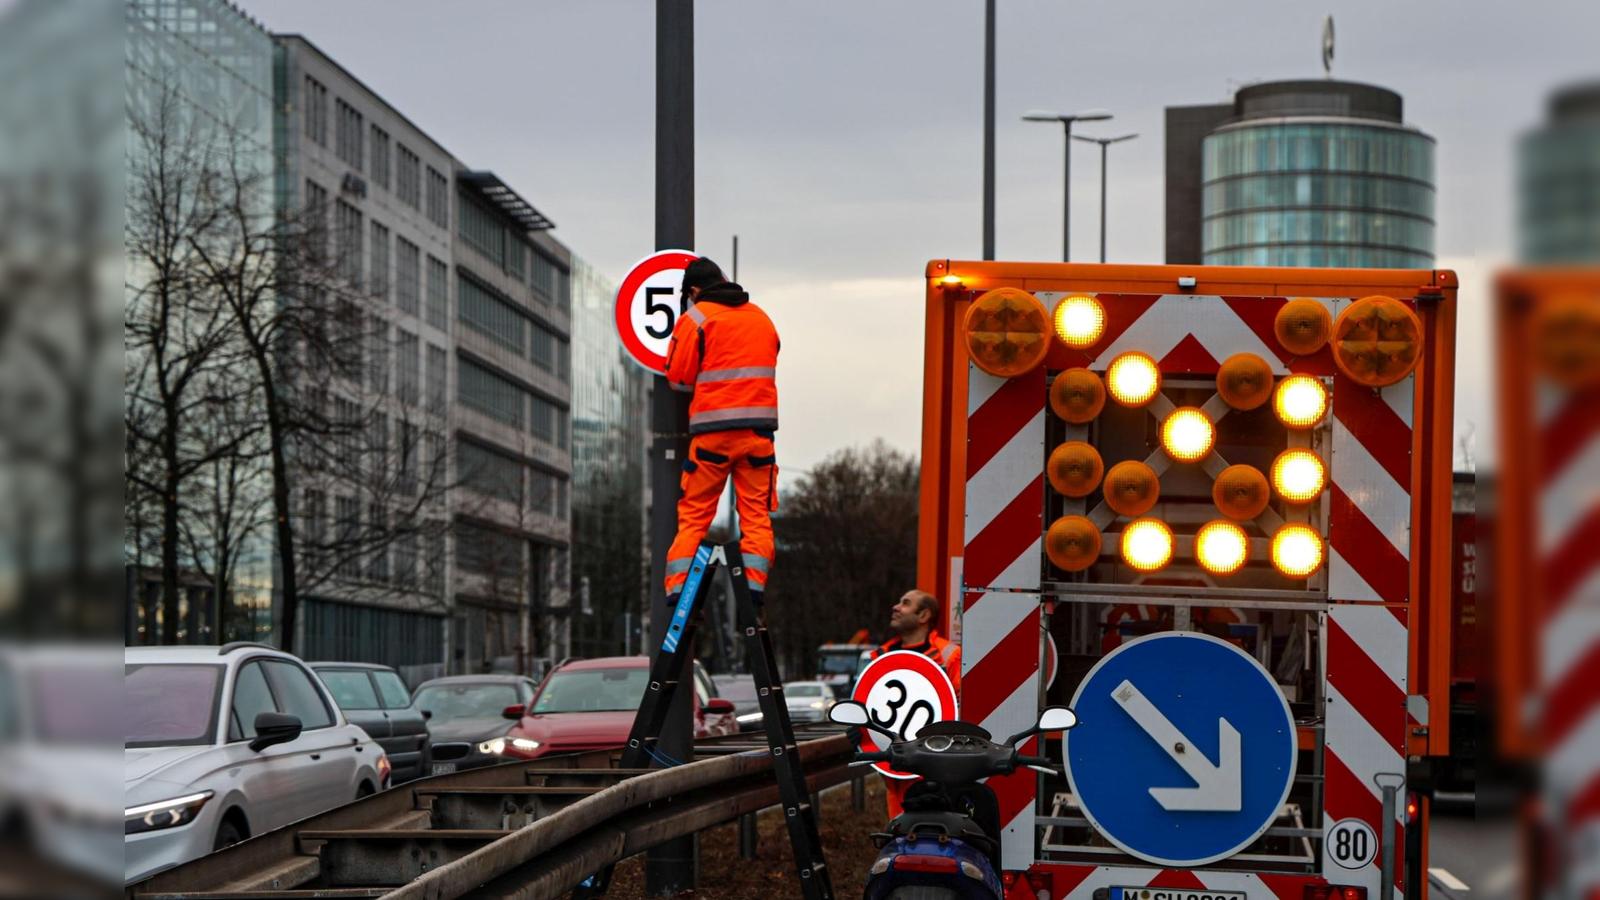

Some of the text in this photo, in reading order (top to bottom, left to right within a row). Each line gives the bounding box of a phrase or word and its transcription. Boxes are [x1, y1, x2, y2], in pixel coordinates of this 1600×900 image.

[644, 287, 688, 340] 5
[871, 679, 935, 741] 30
[1336, 828, 1367, 861] 80
